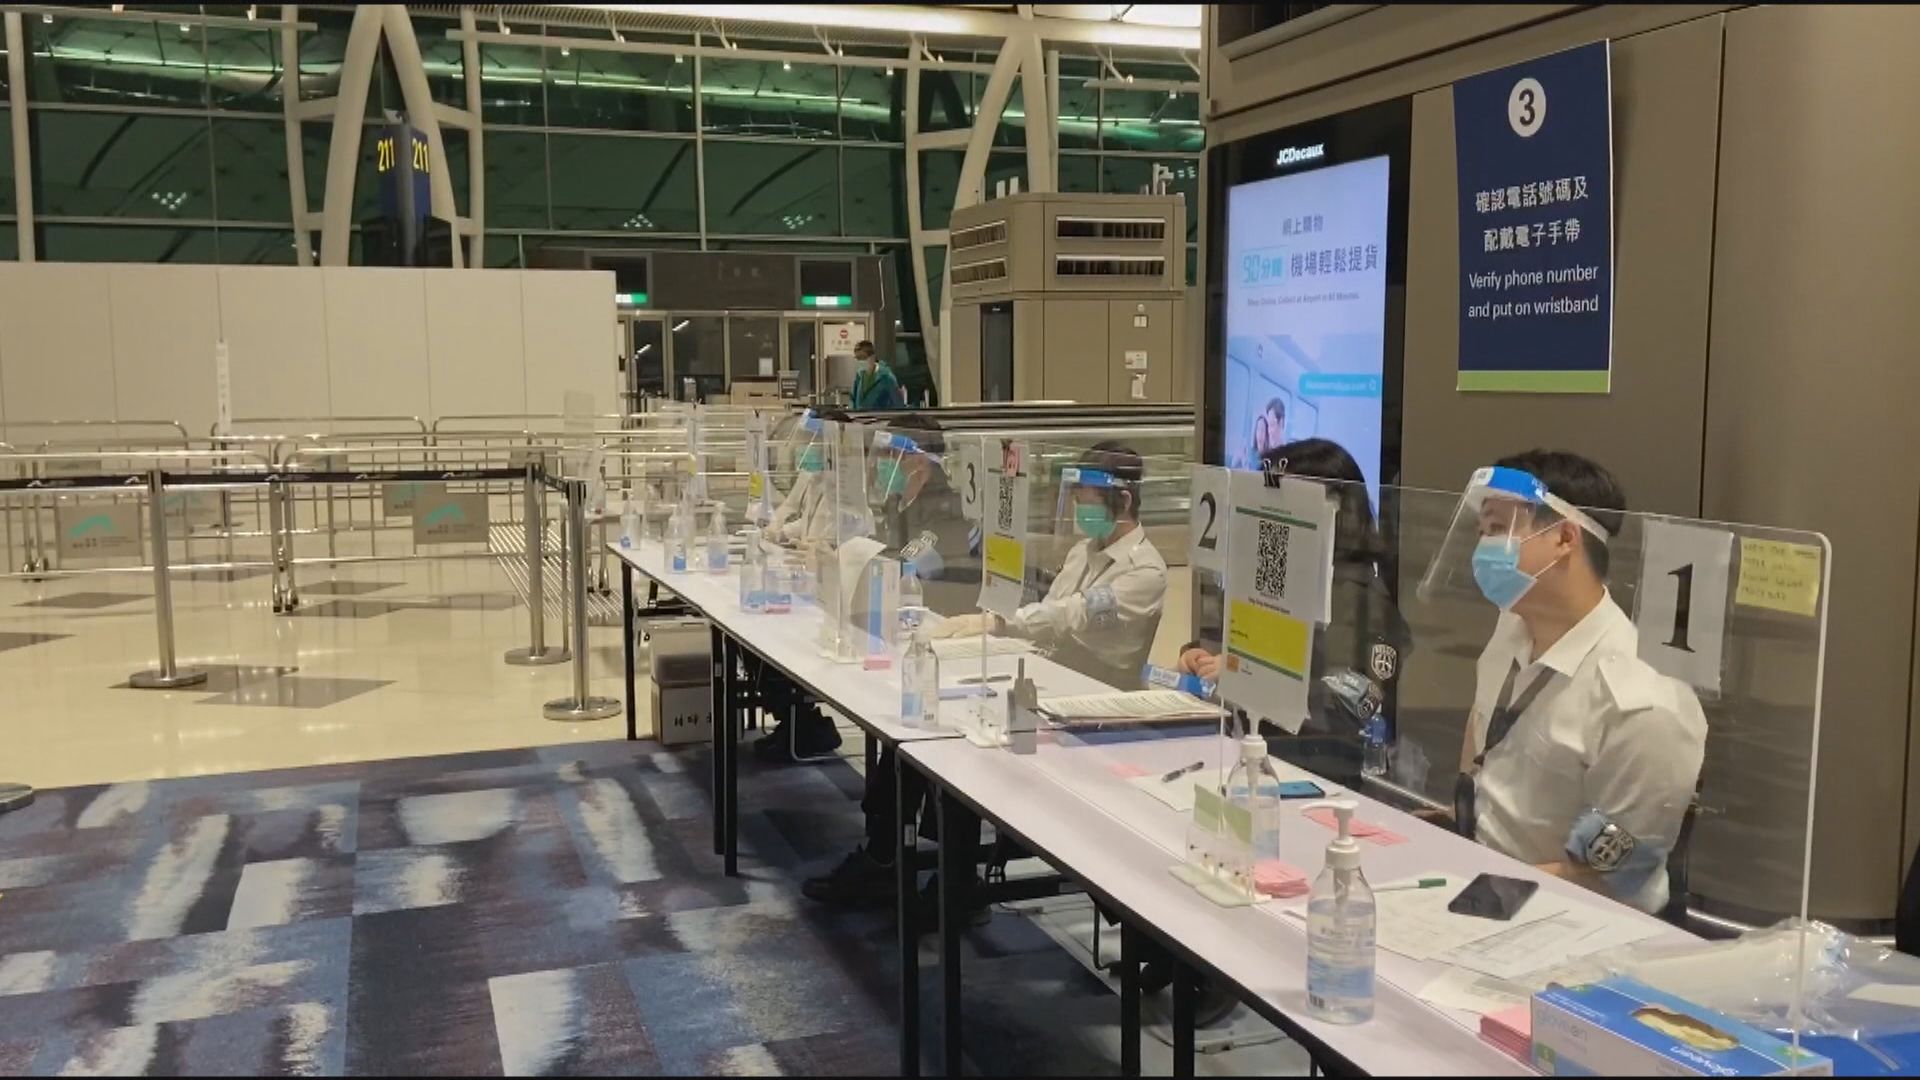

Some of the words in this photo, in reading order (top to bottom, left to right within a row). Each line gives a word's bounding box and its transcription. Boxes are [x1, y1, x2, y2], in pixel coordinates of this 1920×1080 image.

[1519, 88, 1536, 126] 3
[377, 137, 395, 171] 211
[412, 138, 429, 173] 211
[1276, 143, 1325, 166] JCDecaux
[1475, 175, 1589, 213] 確認電話號碼及
[1483, 217, 1581, 253] 配戴電子手帶
[1291, 243, 1379, 278] 機場輕鬆提貨
[1468, 270, 1502, 292] Verify
[1504, 269, 1543, 291] phone
[1546, 263, 1600, 284] number
[1467, 301, 1490, 318] and
[1492, 301, 1512, 321] put
[1515, 302, 1531, 316] on
[1533, 294, 1599, 316] wristband
[966, 462, 977, 504] 3
[1197, 491, 1218, 551] 2
[1661, 563, 1696, 653] 1
